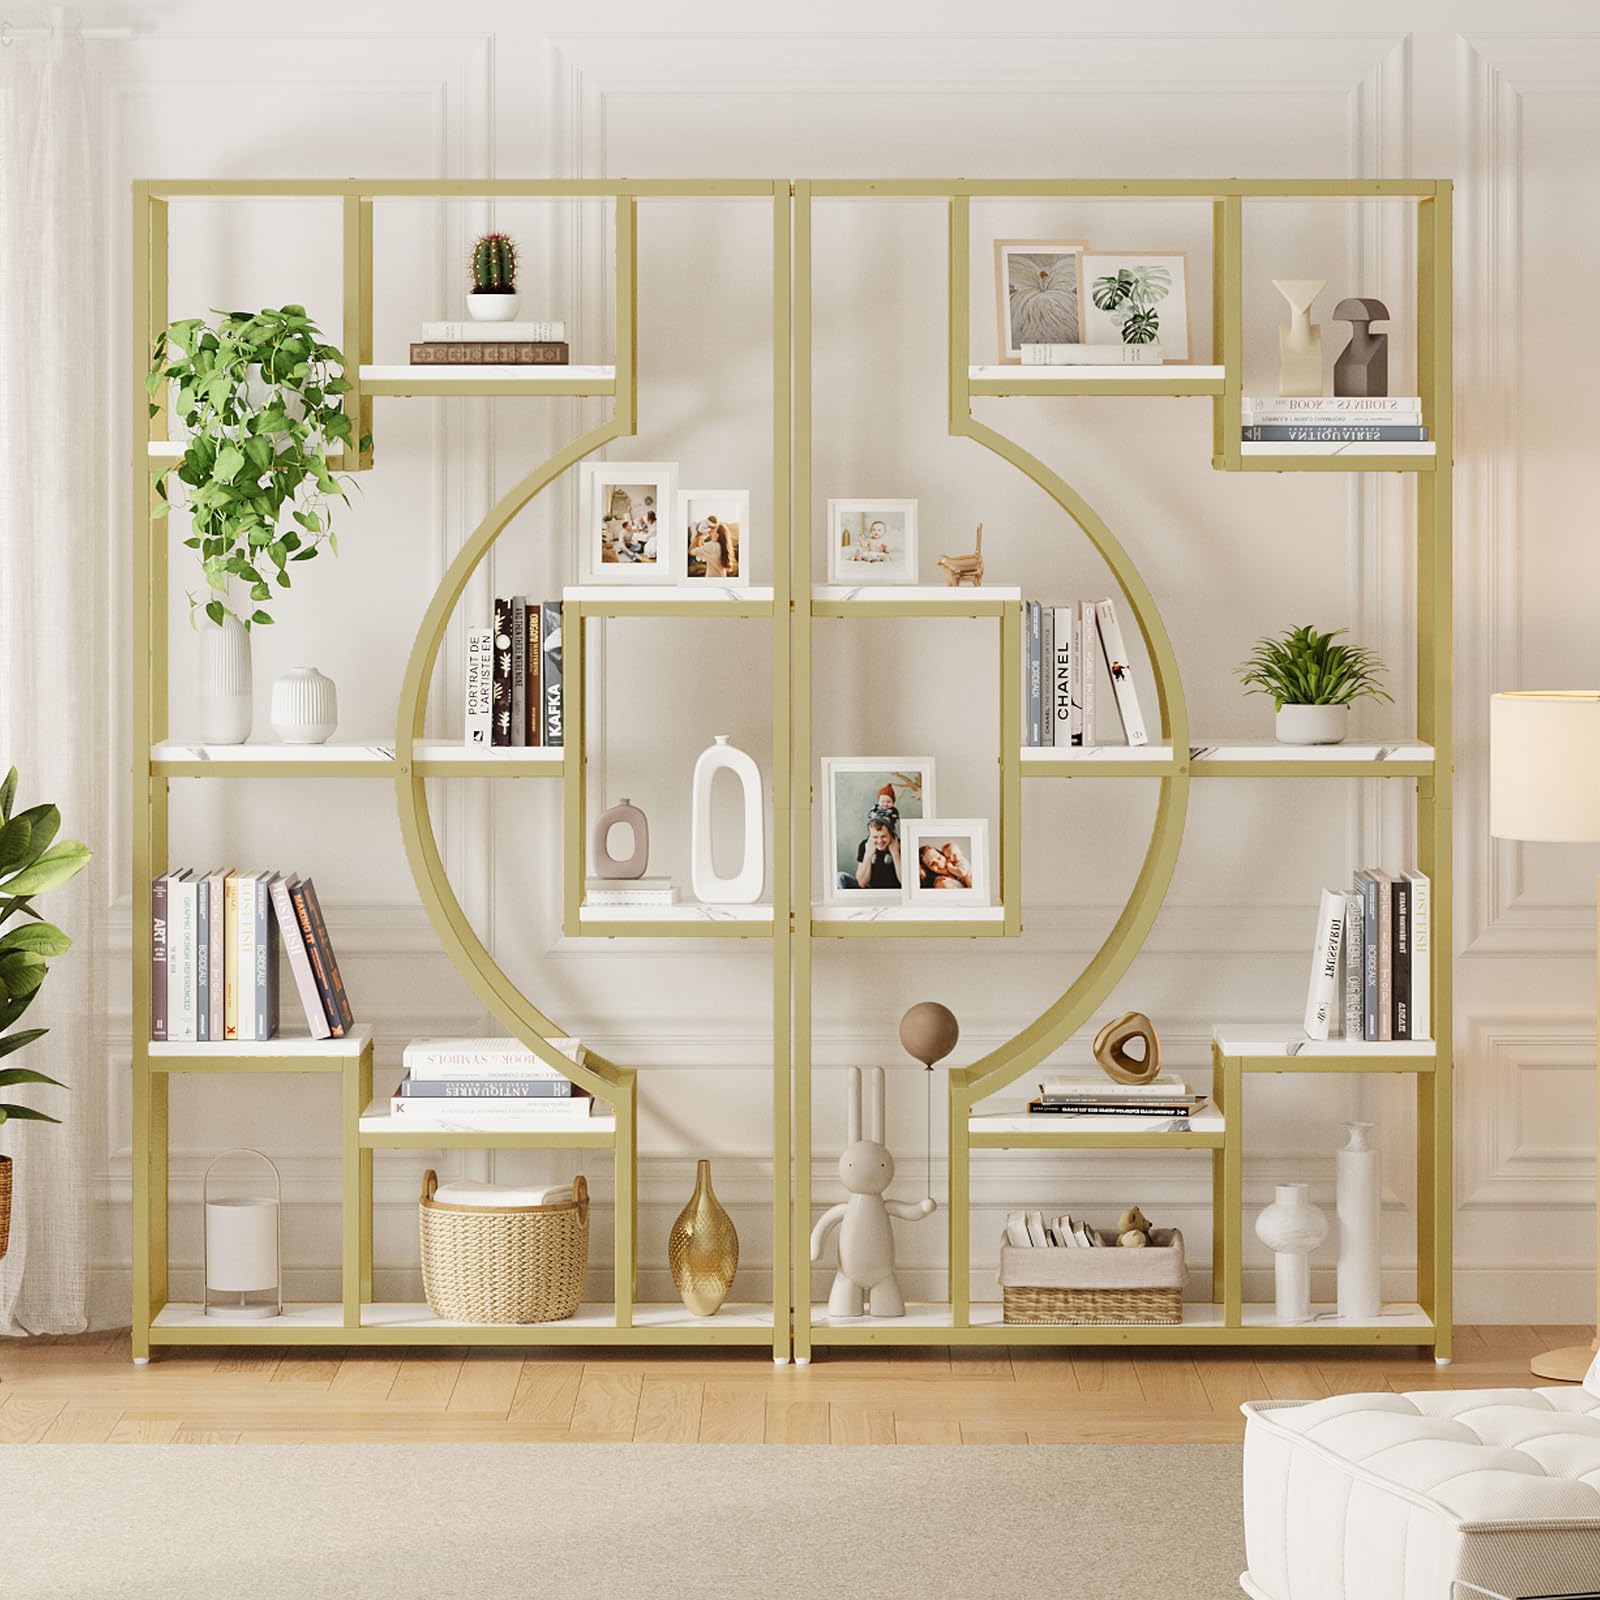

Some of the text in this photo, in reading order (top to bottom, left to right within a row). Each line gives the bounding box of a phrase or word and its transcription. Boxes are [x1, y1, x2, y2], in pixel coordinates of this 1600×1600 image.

[468, 636, 480, 715] PORTRAIT DE
[480, 635, 491, 714] L'ARTISTE EN
[1031, 660, 1040, 698] BORDEAUX
[1057, 642, 1069, 720] CHANEL
[547, 683, 562, 737] KAFKA
[153, 918, 166, 944] ART
[293, 894, 315, 945] MAKING IT
[1416, 883, 1427, 952] LOST FISH
[184, 932, 192, 960] DESIGN
[283, 925, 302, 954] FISH
[198, 944, 208, 986] BORDEAUX
[256, 944, 265, 986] BORDEAUX
[1368, 944, 1376, 987] BORDEAUX
[427, 1055, 488, 1065] SYMBOLS
[502, 1055, 535, 1065] BOOK
[396, 1104, 405, 1112] K
[446, 1085, 529, 1097] ANTIQUAIRES
